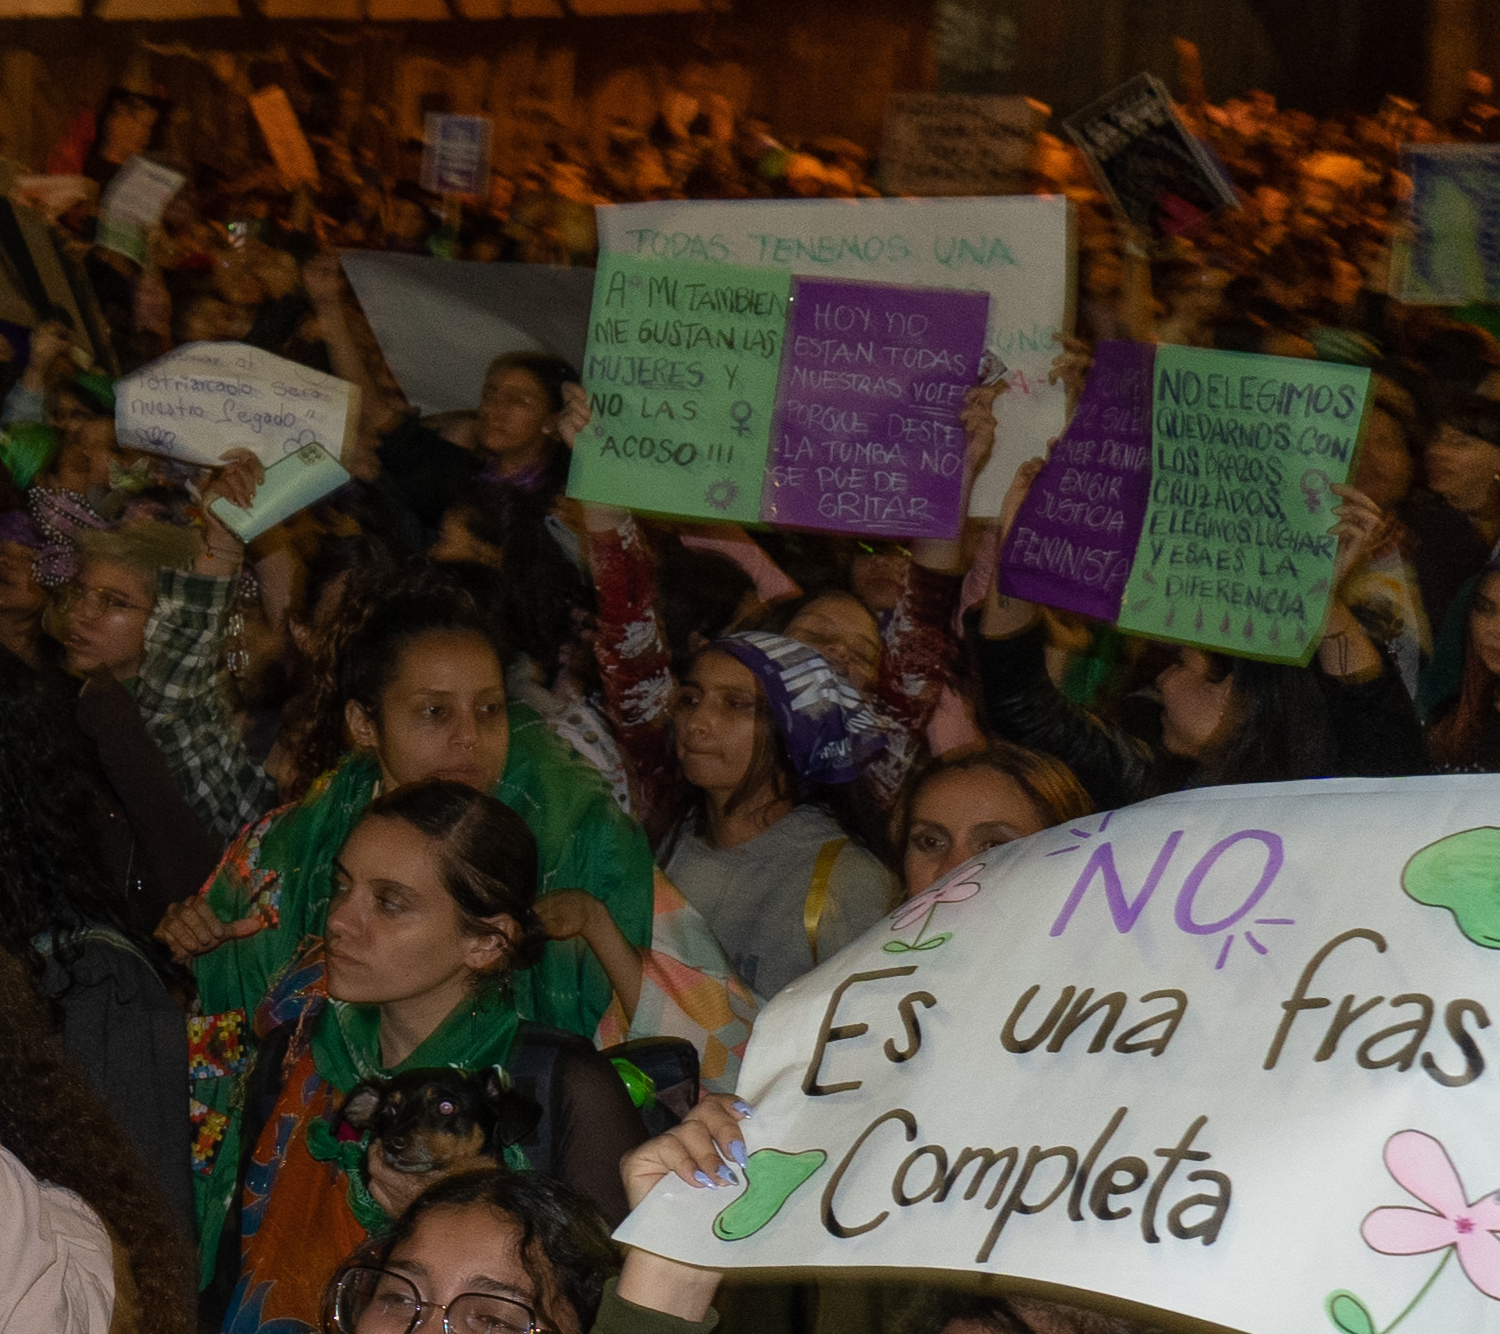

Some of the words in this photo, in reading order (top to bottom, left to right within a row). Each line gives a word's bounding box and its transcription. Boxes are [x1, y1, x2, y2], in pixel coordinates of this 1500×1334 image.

[625, 228, 731, 262] TODAS
[747, 232, 912, 266] TENEMOS
[934, 234, 1017, 268] UNA
[604, 270, 627, 309] A
[813, 302, 872, 332] HOY
[592, 319, 630, 344] ME
[636, 319, 737, 351] GUSTAN
[742, 328, 778, 359] LAS
[793, 335, 875, 366] ESTAN
[882, 346, 969, 377] TODAS
[586, 355, 706, 388] MUJERES
[723, 364, 740, 391] Y
[789, 365, 905, 399] NUESTRAS
[589, 393, 625, 419] NO
[640, 396, 698, 422] LAS
[1159, 368, 1201, 407] NO
[1206, 373, 1358, 421] ELEGIMOS
[886, 412, 958, 448] DESDE
[1156, 408, 1291, 451] QUEDARNOS
[1298, 426, 1350, 463] CON
[600, 435, 699, 467] ACOSO
[782, 433, 815, 461] LA
[820, 440, 907, 465] TUMBA
[920, 448, 961, 478] NO
[1158, 443, 1200, 478] LOS
[1205, 448, 1283, 487] BRAZOS
[817, 492, 933, 522] GRITAR
[1035, 490, 1126, 534] JUSTICIA
[1150, 539, 1164, 567] Y
[1259, 553, 1298, 579] LA
[1256, 525, 1335, 560] LUCHAR
[1165, 574, 1307, 621] DIFERENCIA
[1049, 828, 1284, 939] NO
[799, 965, 938, 1097] Es
[998, 983, 1190, 1058] una
[820, 1105, 1234, 1264] Completa
